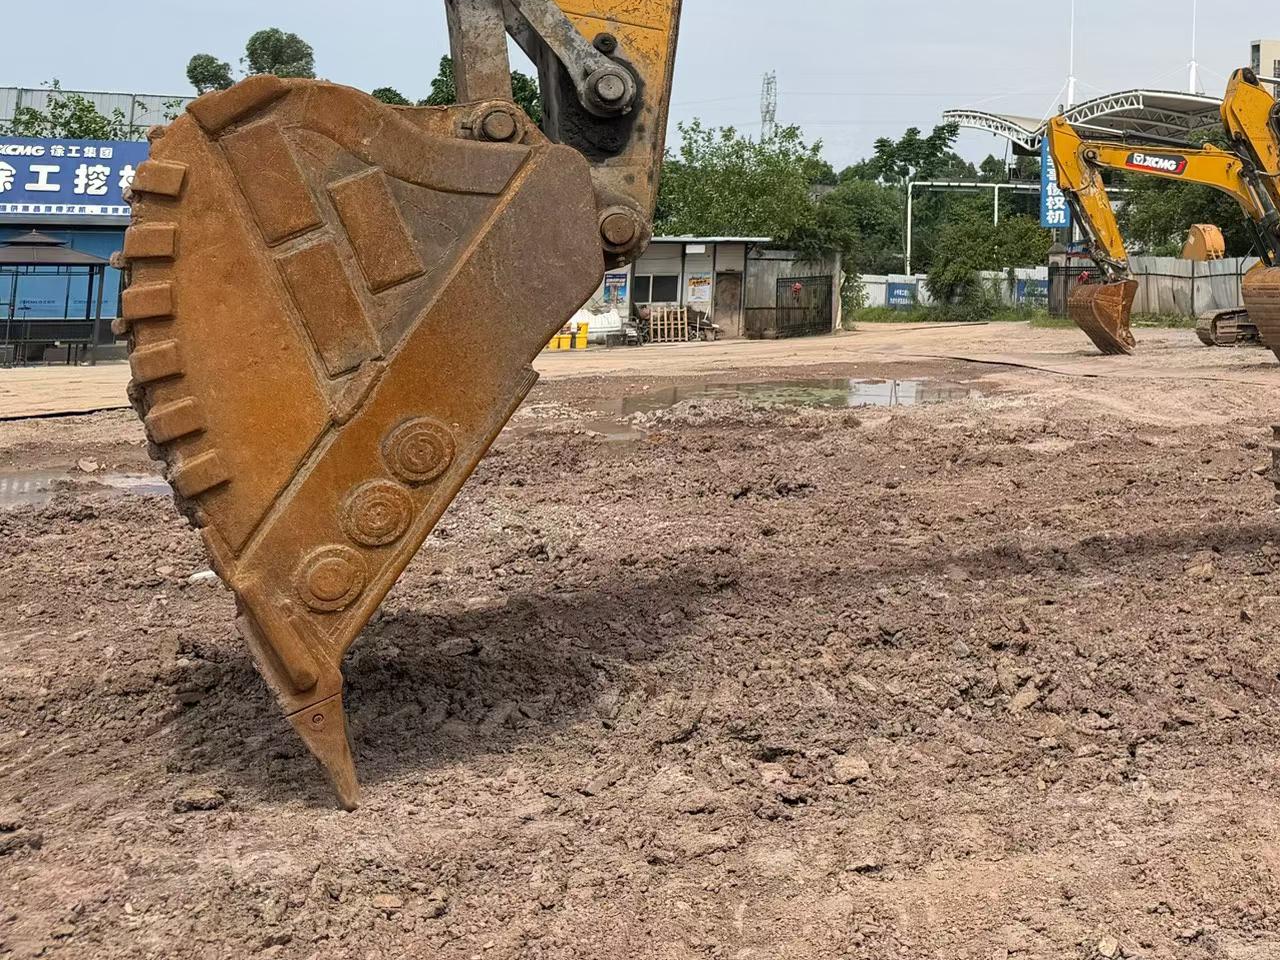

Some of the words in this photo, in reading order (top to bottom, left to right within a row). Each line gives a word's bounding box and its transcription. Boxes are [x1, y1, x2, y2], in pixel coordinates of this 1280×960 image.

[50, 145, 113, 158] 徐工集团
[1143, 155, 1177, 171] XCMG
